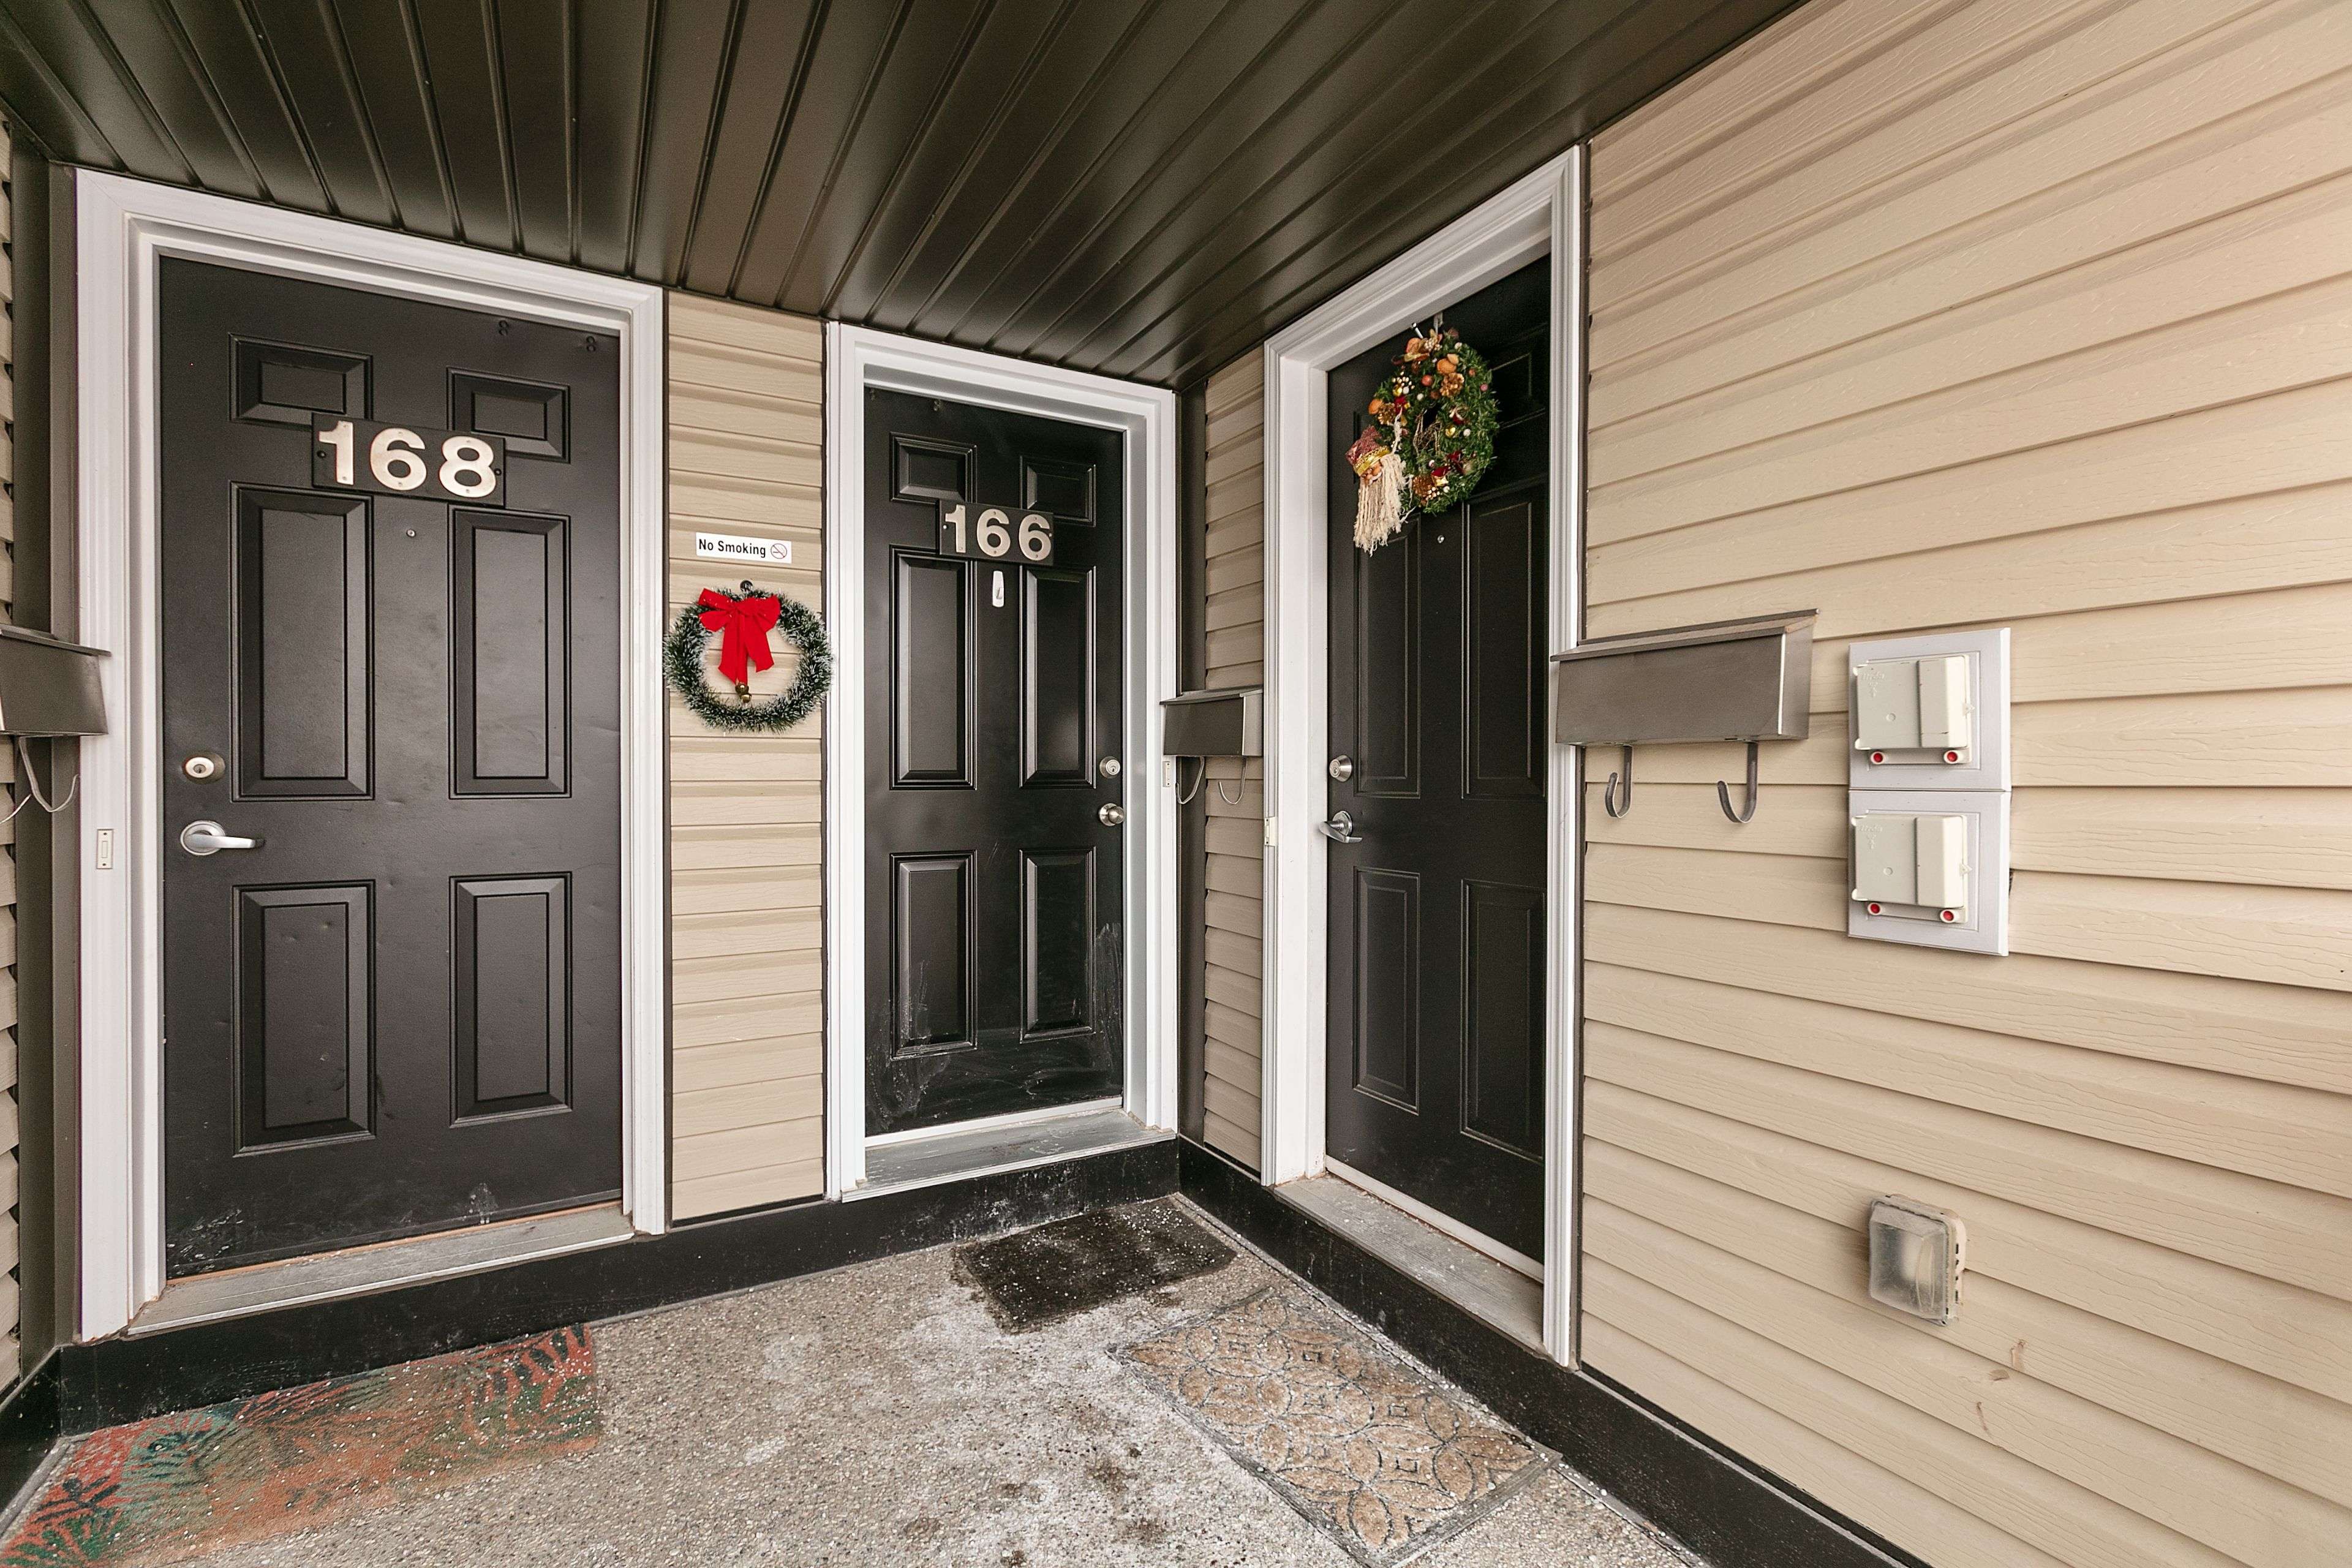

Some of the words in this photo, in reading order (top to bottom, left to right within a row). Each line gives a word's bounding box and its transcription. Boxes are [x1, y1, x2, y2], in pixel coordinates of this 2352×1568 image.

[318, 420, 497, 498] 168
[699, 538, 714, 551] No
[718, 540, 766, 559] Smoking
[945, 504, 1052, 561] 166
